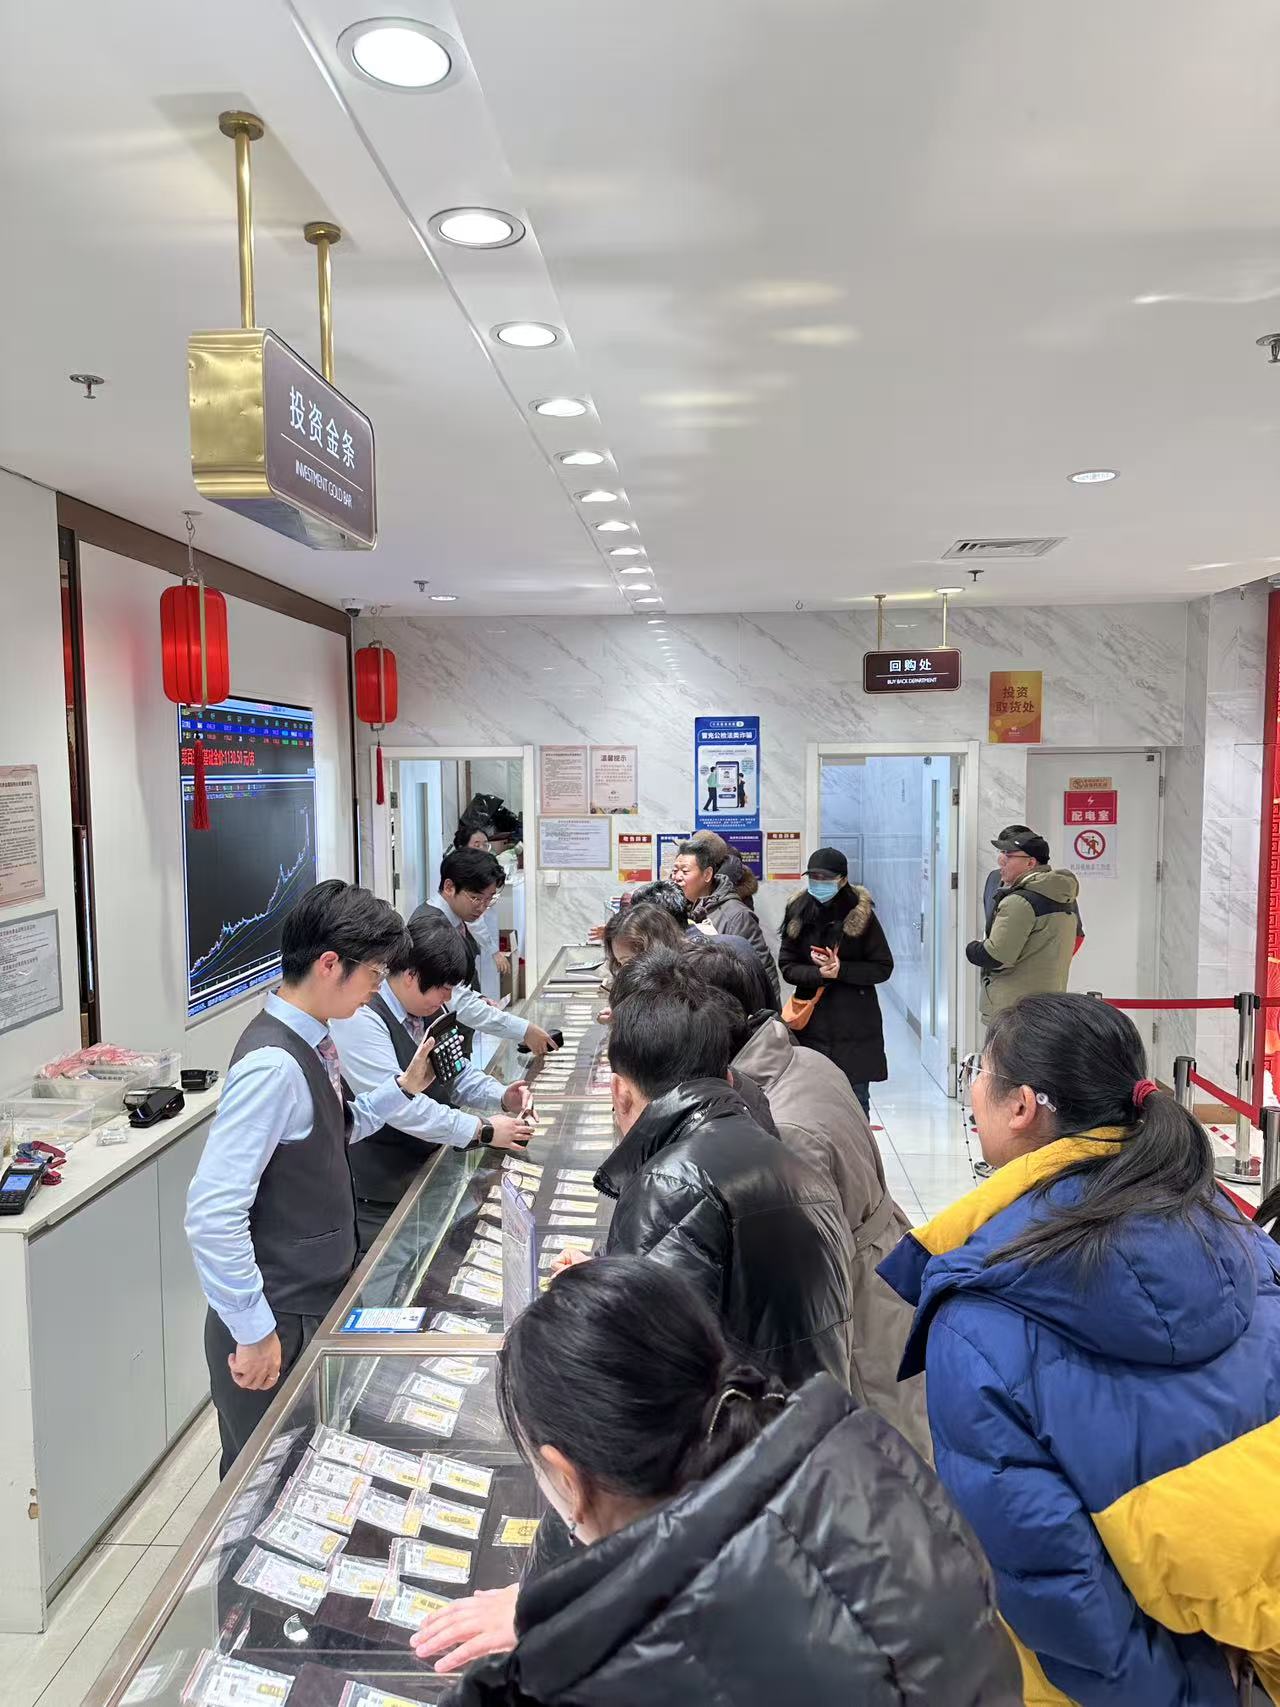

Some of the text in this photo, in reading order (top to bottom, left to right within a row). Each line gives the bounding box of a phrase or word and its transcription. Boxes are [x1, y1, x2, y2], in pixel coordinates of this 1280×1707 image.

[289, 385, 355, 469] 投资金条
[295, 459, 328, 491] INVESTMENT
[328, 481, 343, 502] GOLD
[889, 659, 932, 672] 回购处
[1002, 686, 1029, 699] 投资
[995, 701, 1035, 713] 取货处
[600, 754, 628, 762] 温馨提示
[1071, 810, 1110, 821] 配电室
